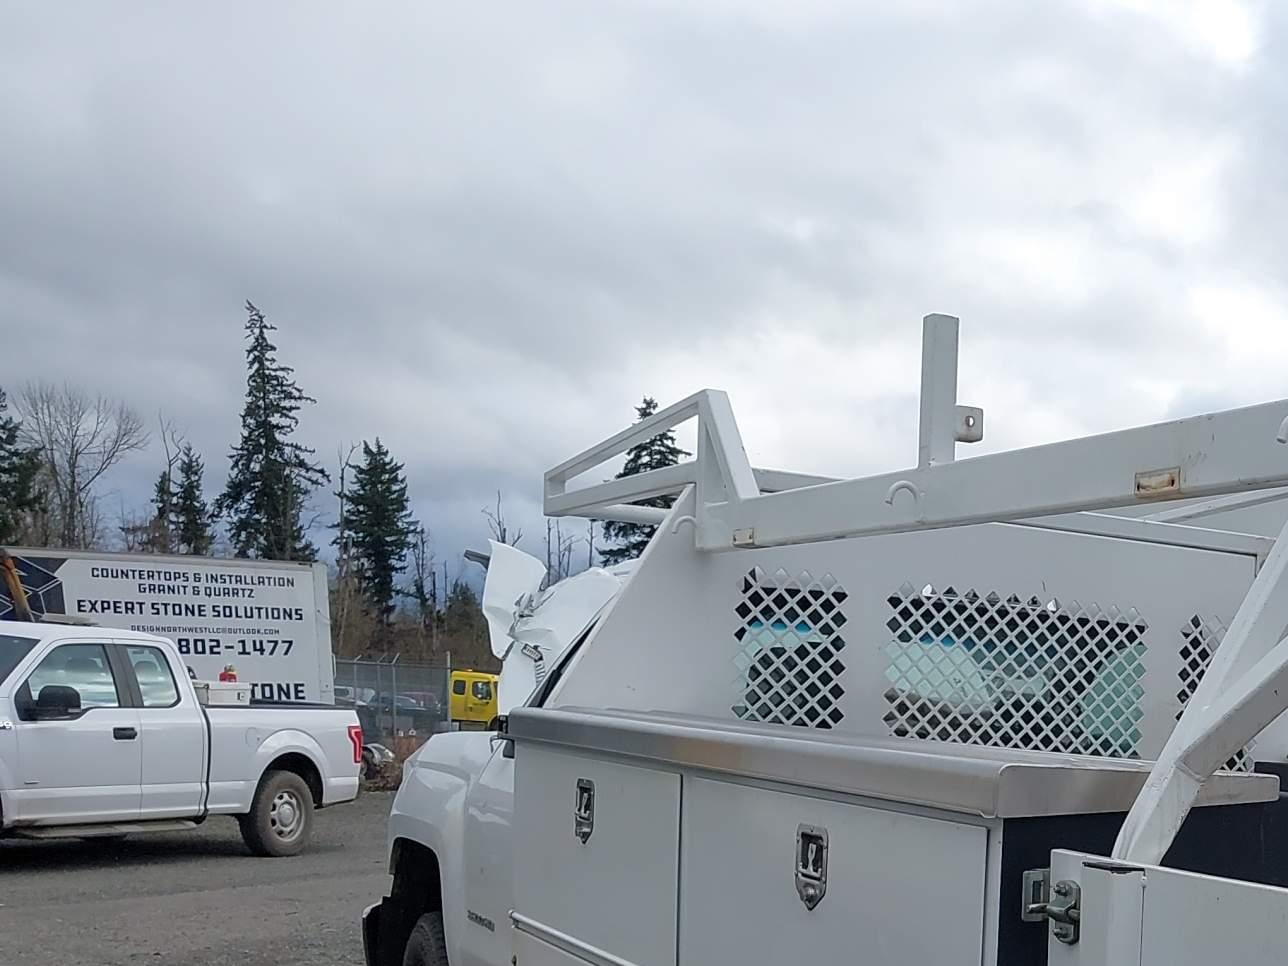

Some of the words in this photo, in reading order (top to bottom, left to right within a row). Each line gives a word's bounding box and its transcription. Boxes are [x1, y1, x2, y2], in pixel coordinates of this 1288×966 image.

[91, 567, 189, 582] COUNTERTOPS
[193, 572, 201, 583] &
[205, 573, 295, 588] INSTALLATION
[138, 583, 188, 595] GRANIT
[192, 585, 201, 596] &
[204, 586, 255, 598] QUARTZ
[77, 599, 146, 615] EXPERT
[151, 602, 207, 617] STONE
[212, 604, 304, 621] SOLUTIONS
[177, 638, 294, 656] 802-1477
